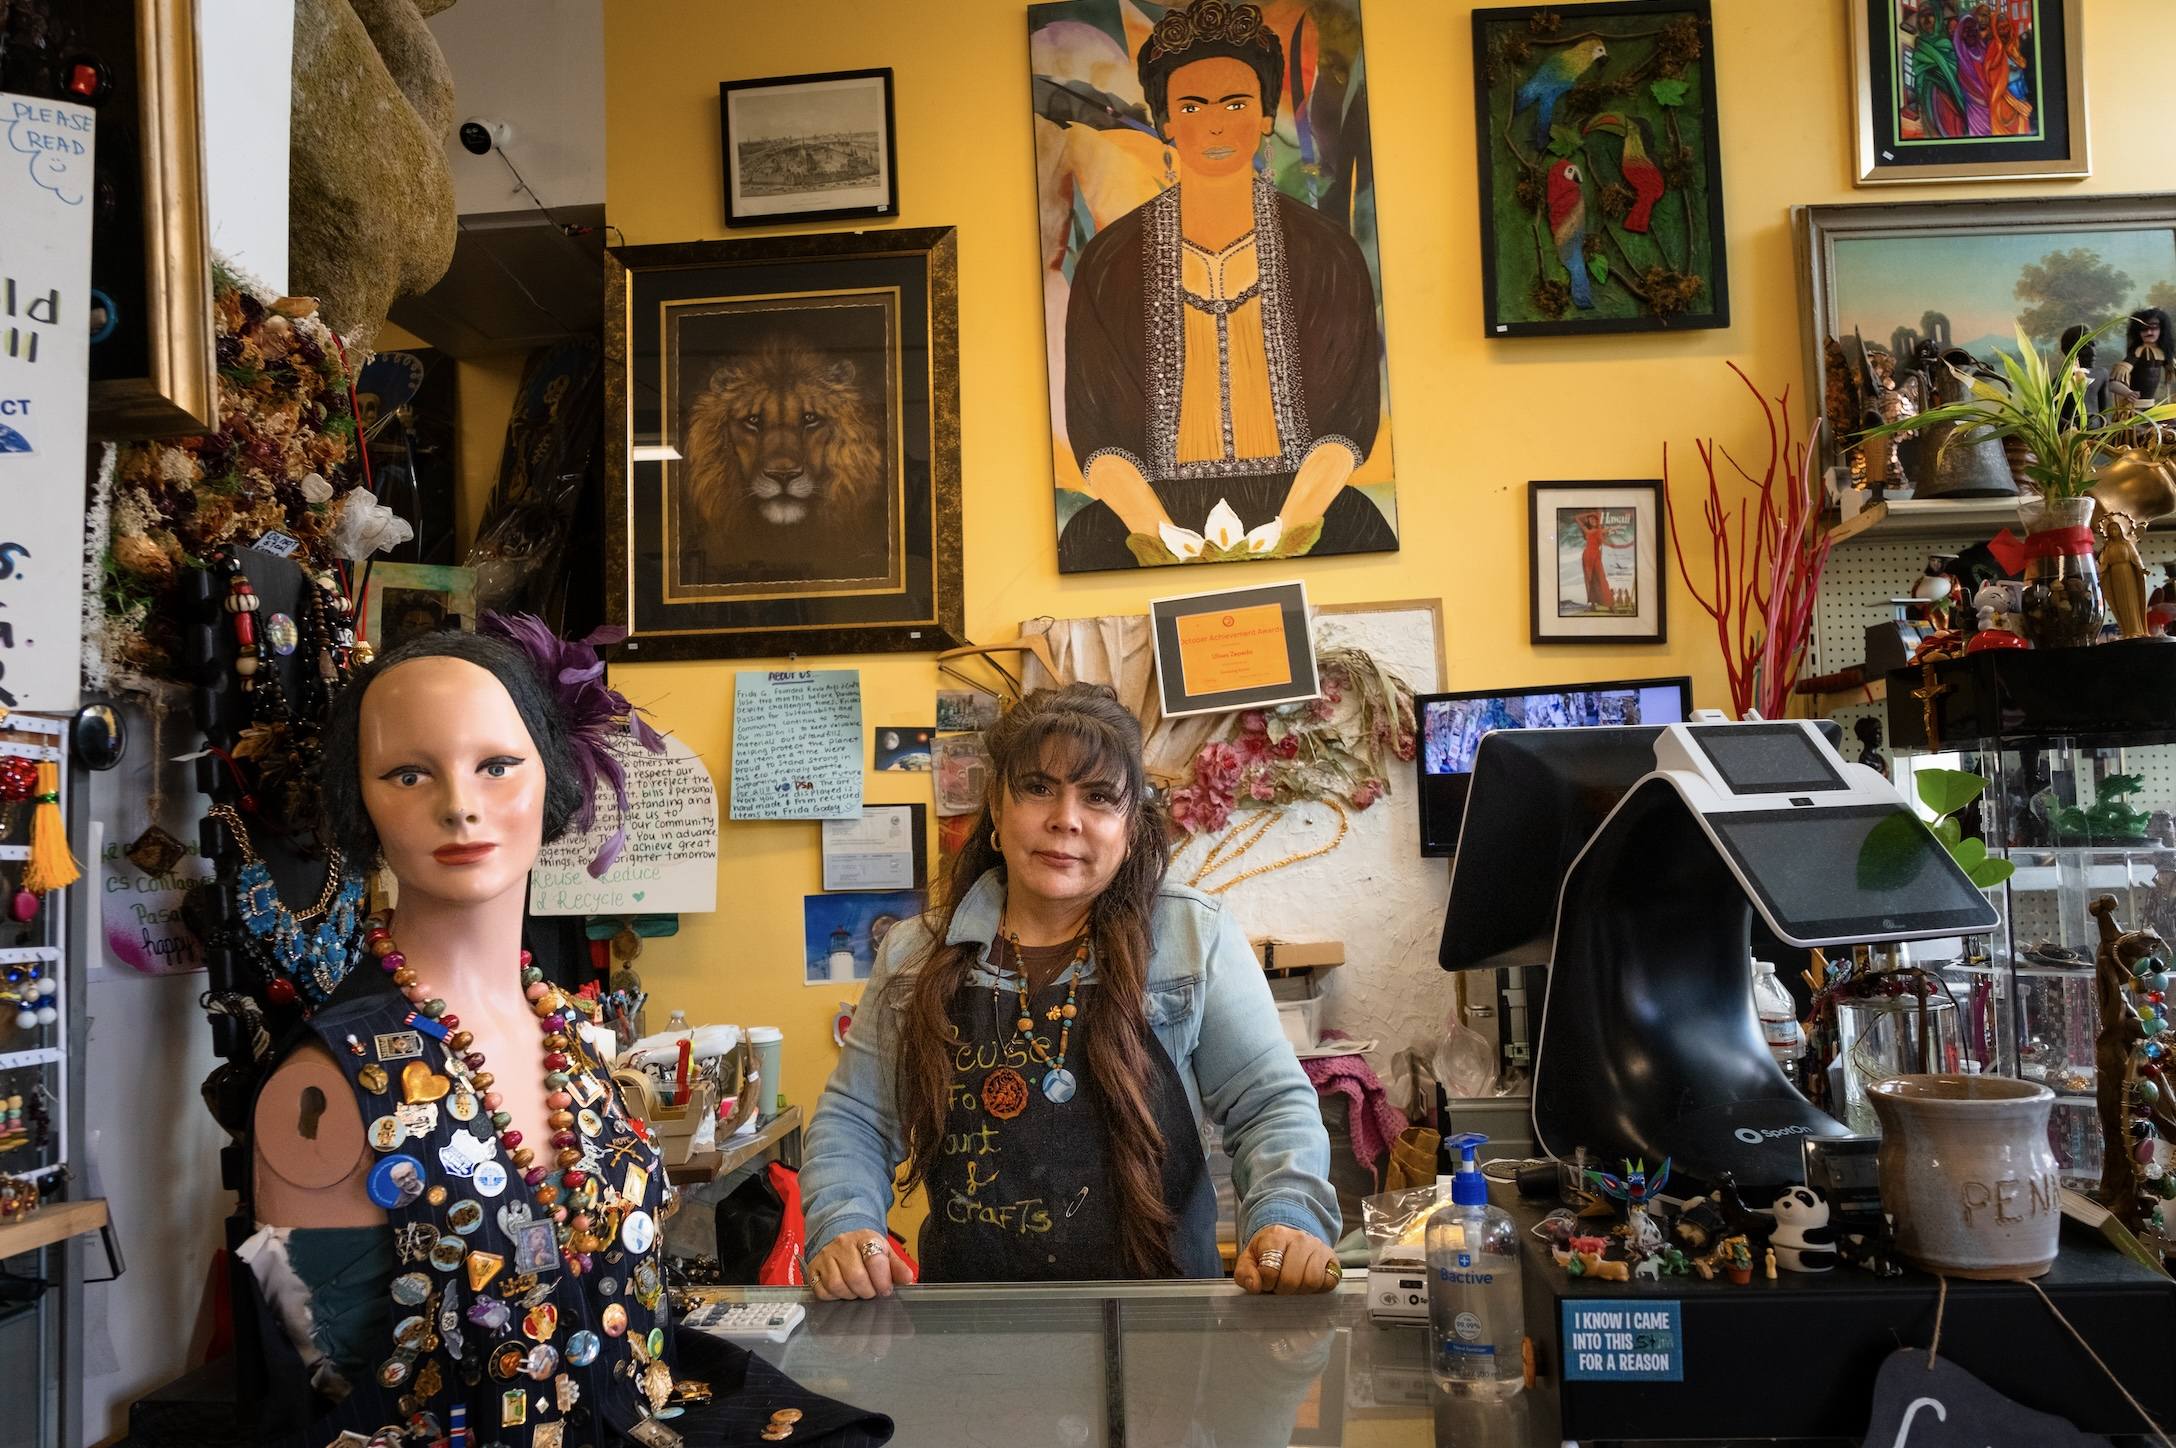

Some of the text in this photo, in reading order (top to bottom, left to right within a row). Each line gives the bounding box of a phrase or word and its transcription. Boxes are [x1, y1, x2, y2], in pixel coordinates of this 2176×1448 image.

[13, 102, 92, 132] PLEASE
[27, 131, 85, 155] READ
[768, 670, 811, 681] ABOUT US
[694, 775, 710, 784] the
[688, 797, 711, 805] and
[645, 812, 659, 820] us
[661, 829, 673, 839] in
[632, 841, 673, 851] achieve
[678, 839, 711, 852] great
[557, 890, 624, 912] Recycle
[1762, 1125, 1814, 1139] SpotOn
[1575, 1312, 1670, 1329] I KNOW I CAME
[1572, 1333, 1602, 1350] INTO
[1604, 1333, 1633, 1350] THIS
[1579, 1353, 1670, 1371] FOR A REASON
